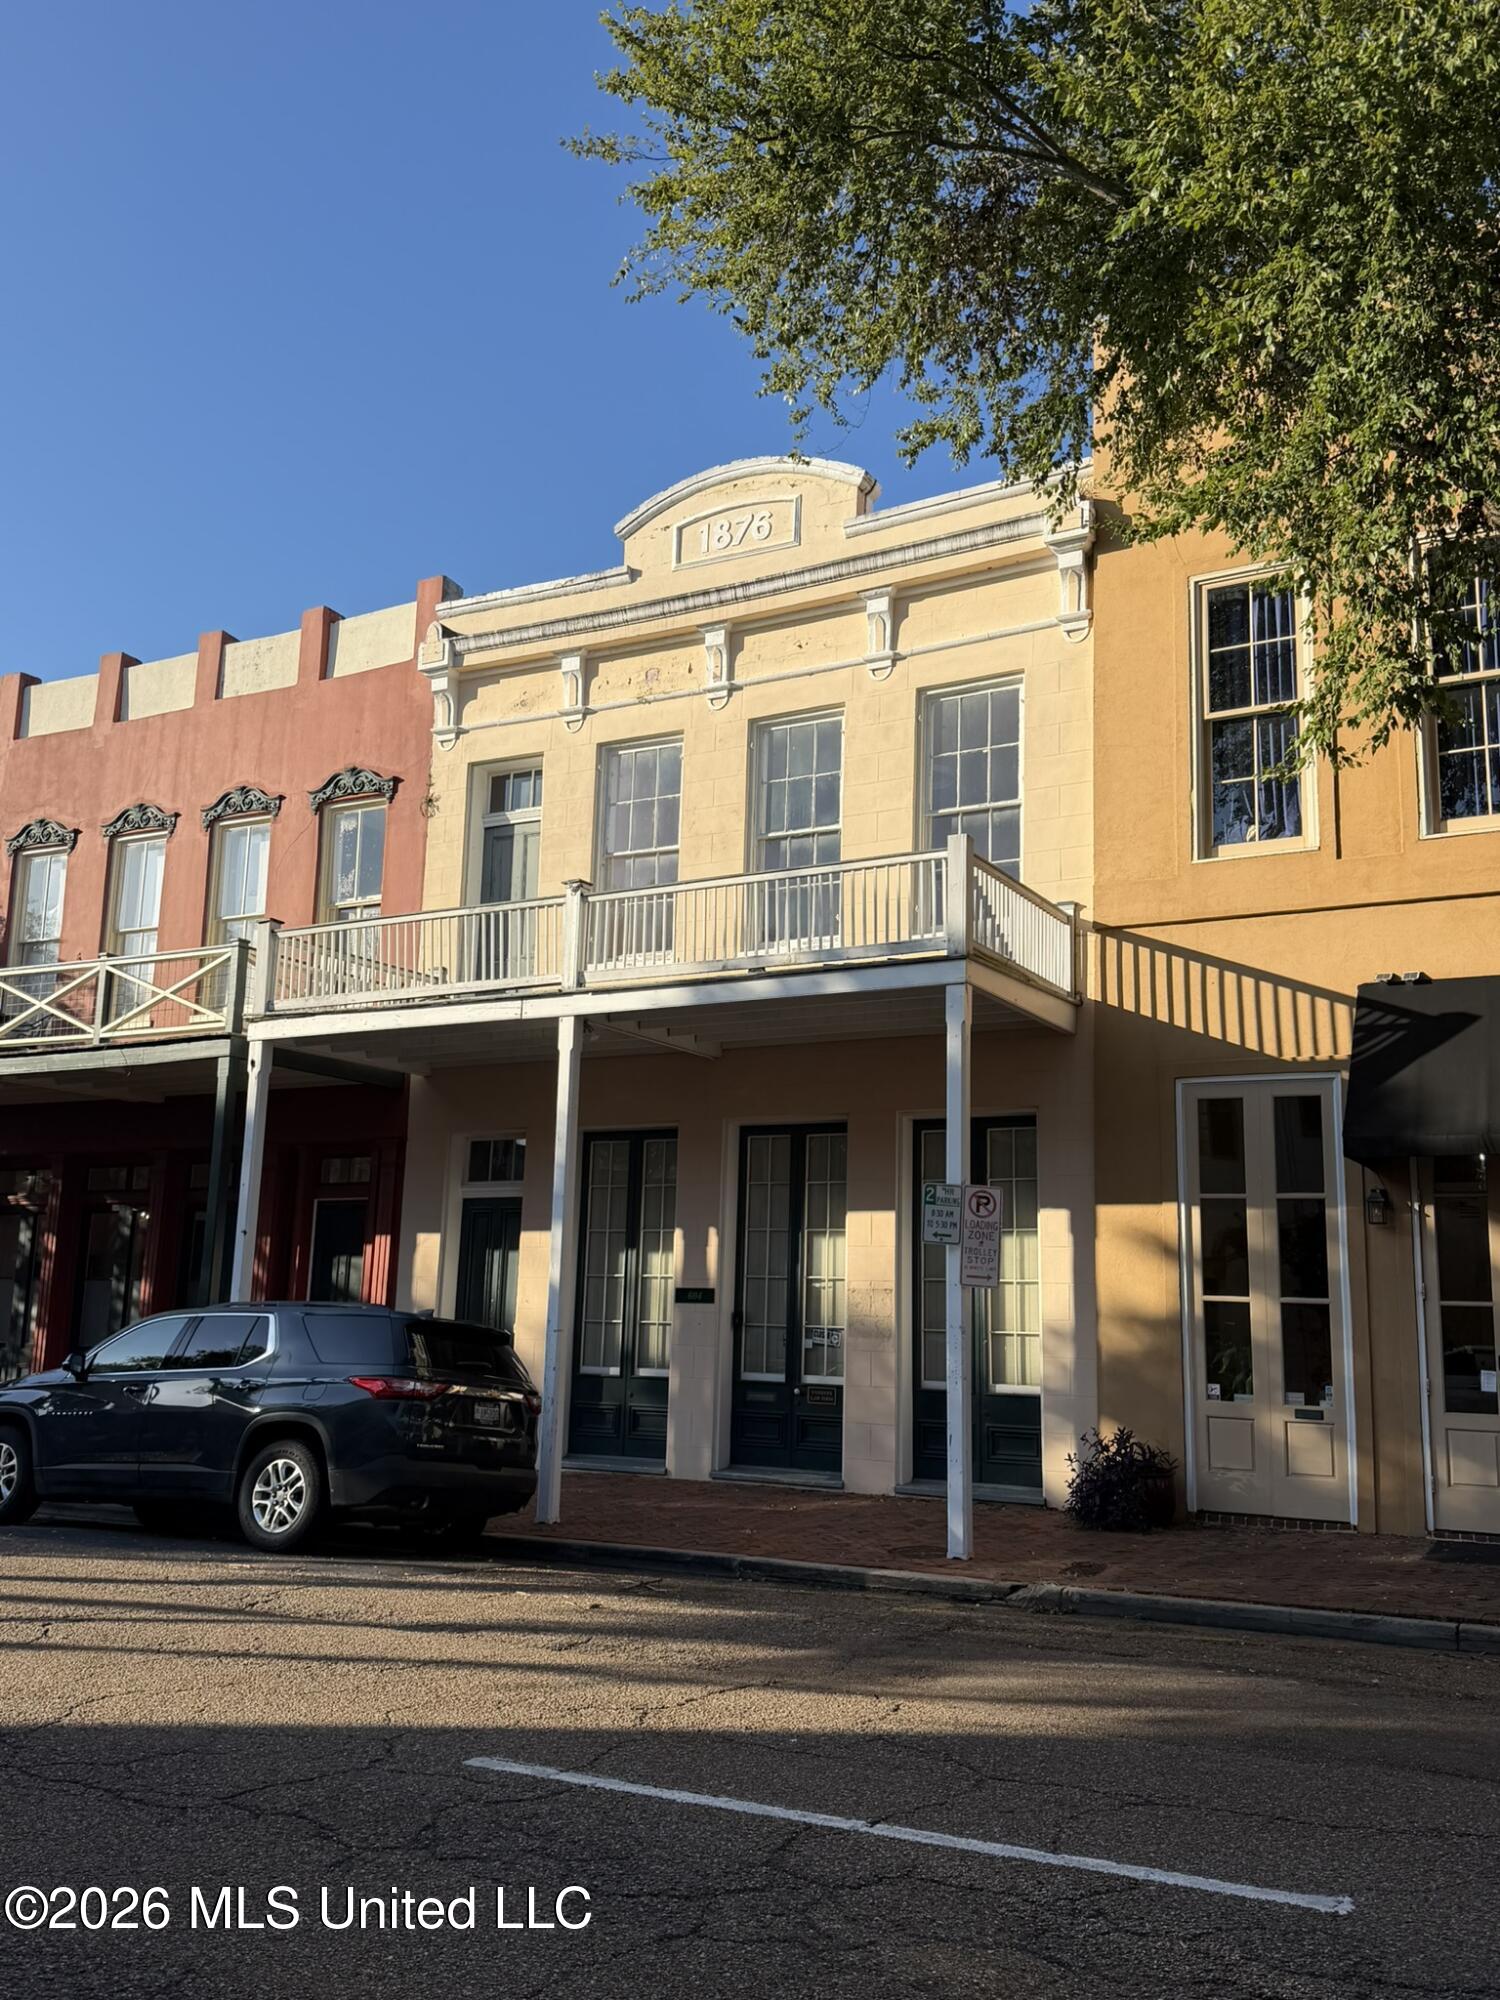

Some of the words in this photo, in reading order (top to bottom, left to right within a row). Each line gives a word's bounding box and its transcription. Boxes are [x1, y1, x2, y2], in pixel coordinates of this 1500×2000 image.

[700, 510, 773, 554] 1876
[926, 1187, 936, 1202] 2
[945, 1210, 954, 1219] AM
[949, 1221, 958, 1230] PM
[965, 1219, 999, 1231] LOADING
[968, 1230, 995, 1242] ZONE
[964, 1246, 997, 1257] TROLLEY
[967, 1256, 994, 1265] STOP
